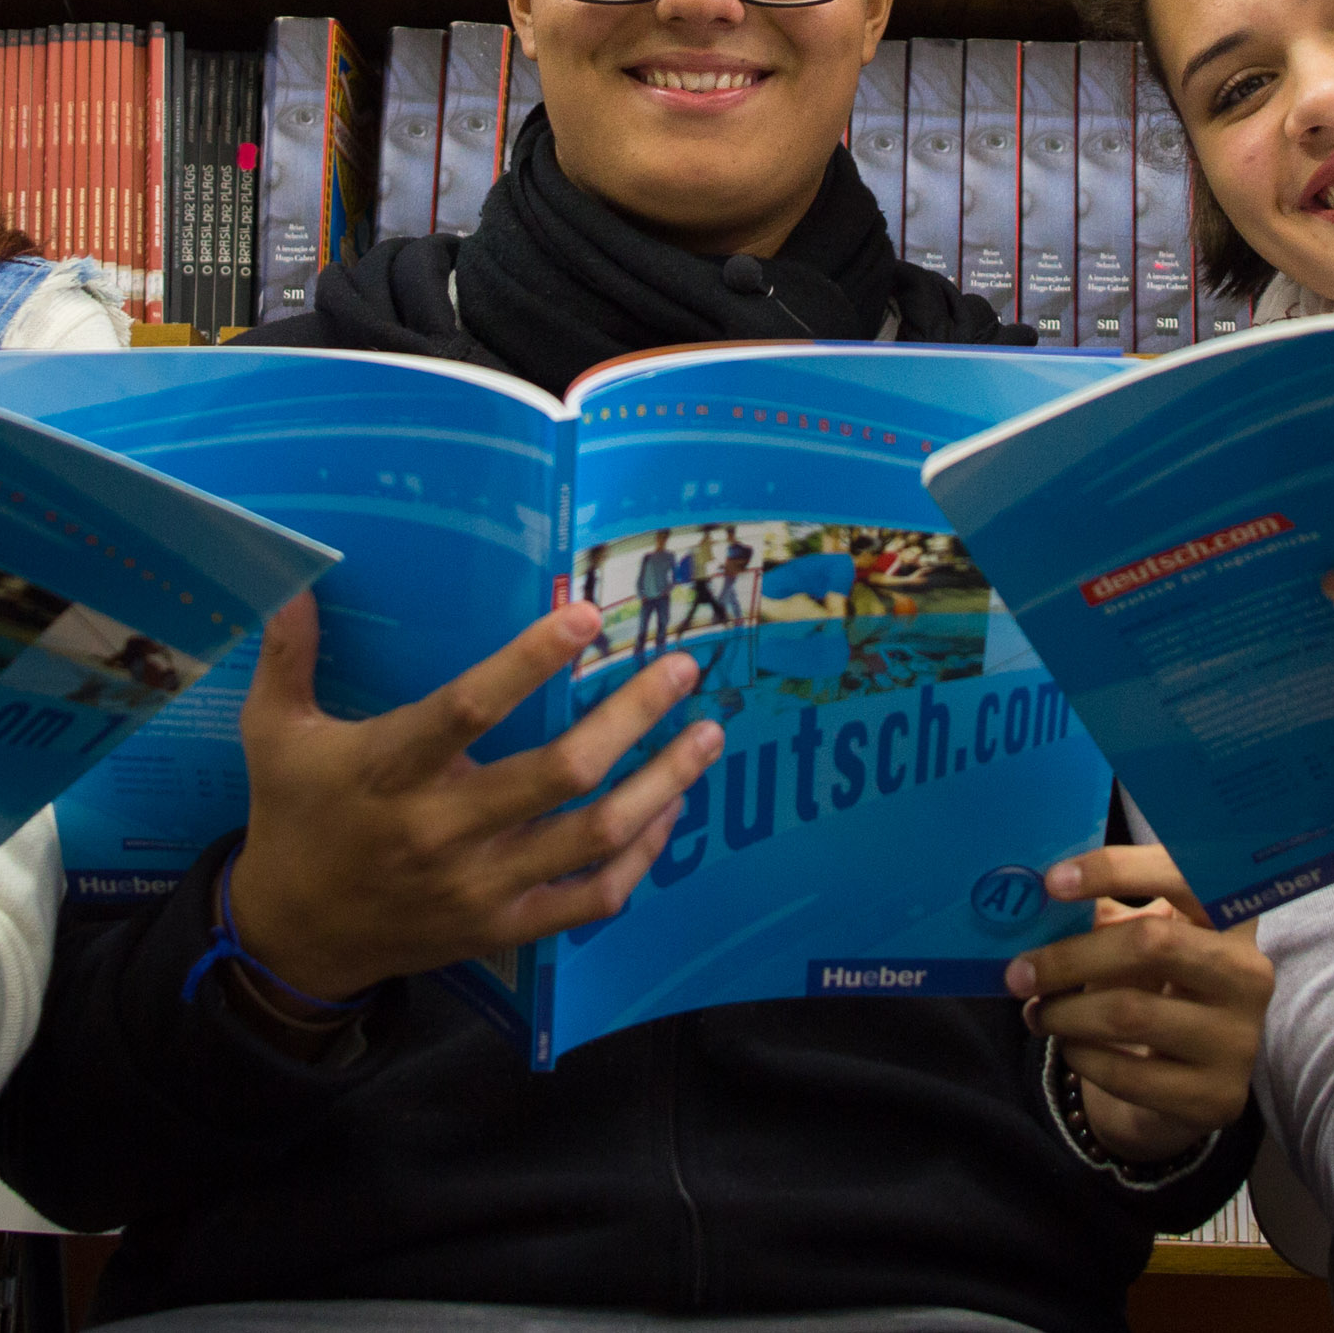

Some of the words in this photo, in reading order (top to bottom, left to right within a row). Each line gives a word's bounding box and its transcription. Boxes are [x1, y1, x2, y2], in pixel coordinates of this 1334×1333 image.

[283, 289, 304, 299] sm
[1039, 319, 1061, 331] sm
[1097, 318, 1119, 330] sm
[1157, 317, 1178, 329] sm
[1093, 516, 1280, 598] deutsch.com
[605, 681, 1066, 913] eutsch.com
[79, 876, 178, 897] Hueber
[1221, 867, 1323, 919] Hueber
[984, 881, 1035, 918] A1
[822, 968, 927, 988] Hueber
